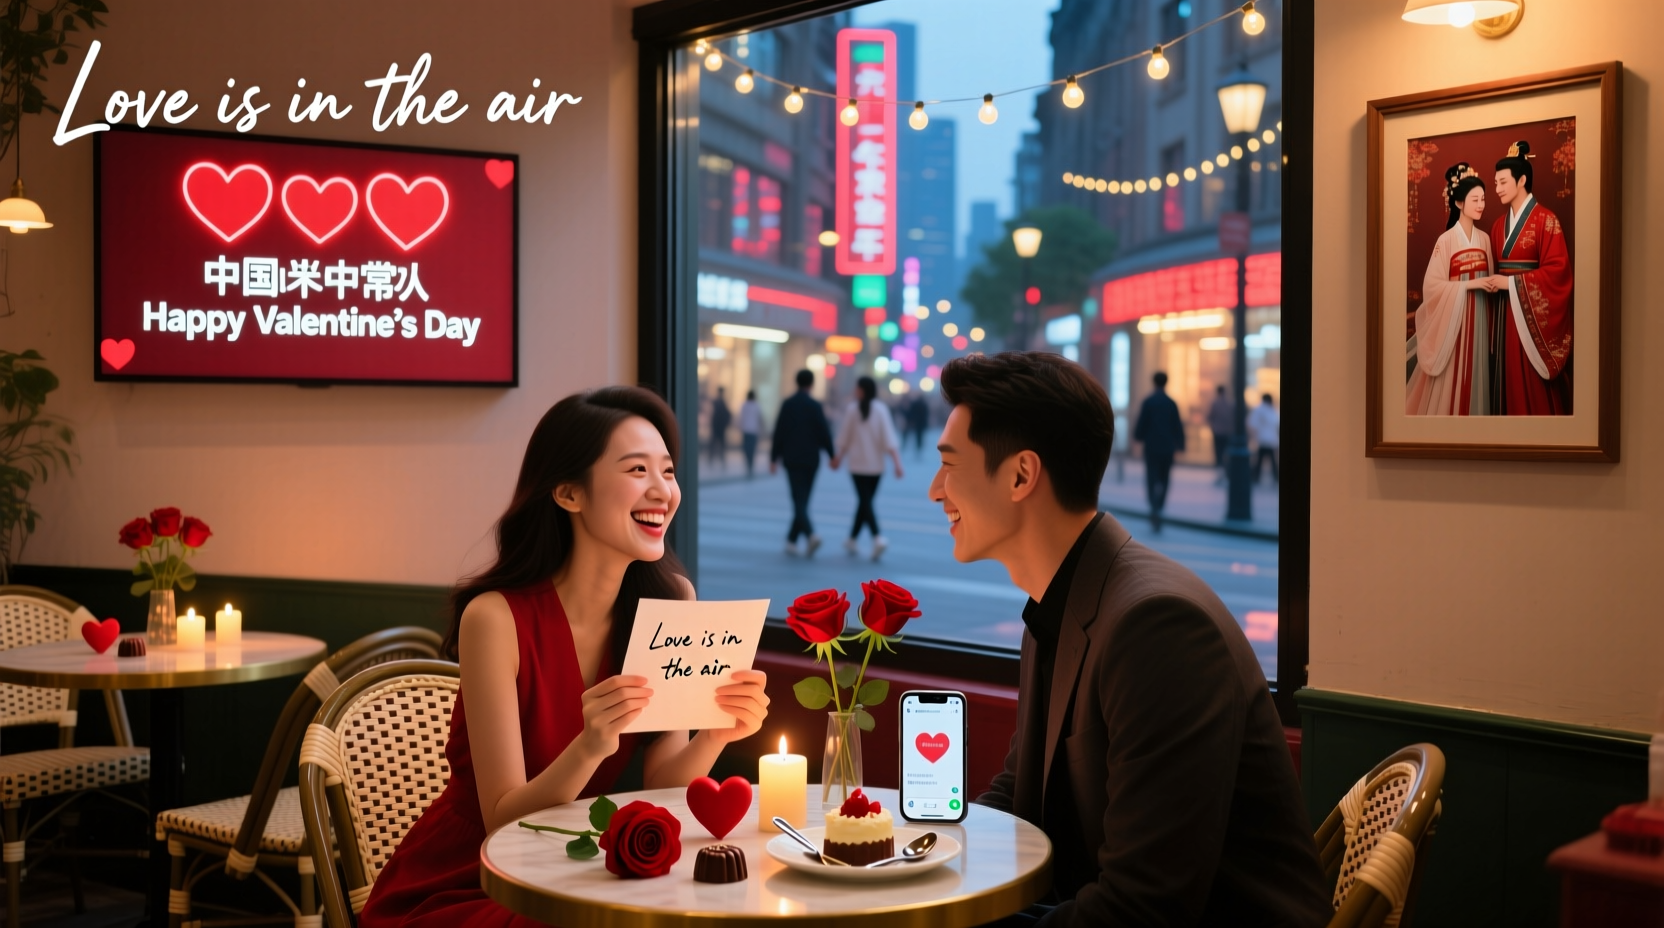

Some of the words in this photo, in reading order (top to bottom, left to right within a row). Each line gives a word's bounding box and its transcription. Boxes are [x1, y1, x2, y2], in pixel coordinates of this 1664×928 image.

[142, 301, 247, 342] Happy
[424, 309, 482, 348] Day
[648, 621, 693, 651] Love
[701, 630, 715, 648] is
[721, 630, 743, 646] in
[660, 657, 694, 681] the
[700, 658, 732, 676] air
